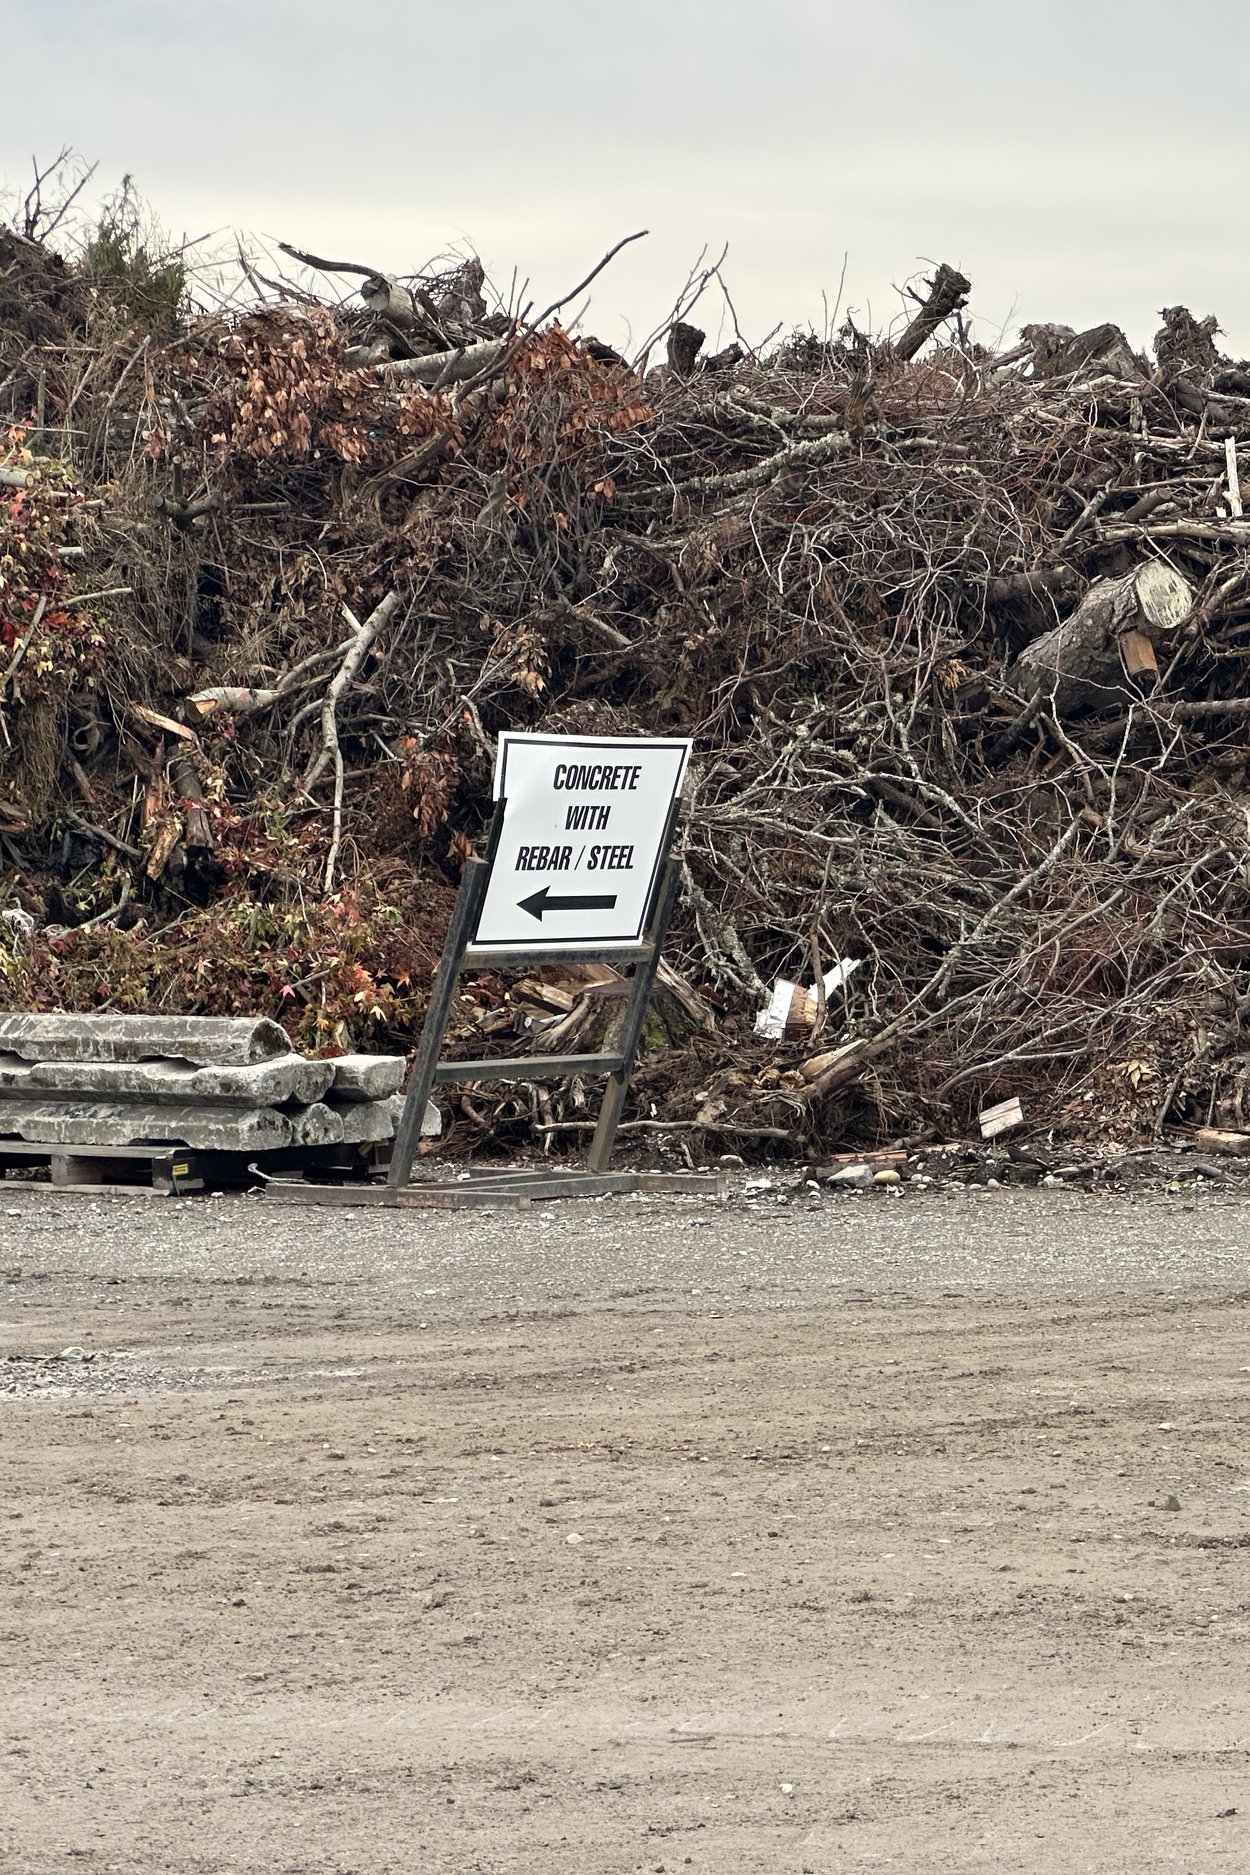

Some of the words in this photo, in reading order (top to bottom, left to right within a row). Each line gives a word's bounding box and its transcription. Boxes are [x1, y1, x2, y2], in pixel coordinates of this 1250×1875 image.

[553, 764, 642, 790] CONCRETE
[565, 805, 612, 830] WITH
[515, 846, 573, 871] REBAR
[587, 845, 635, 870] STEEL
